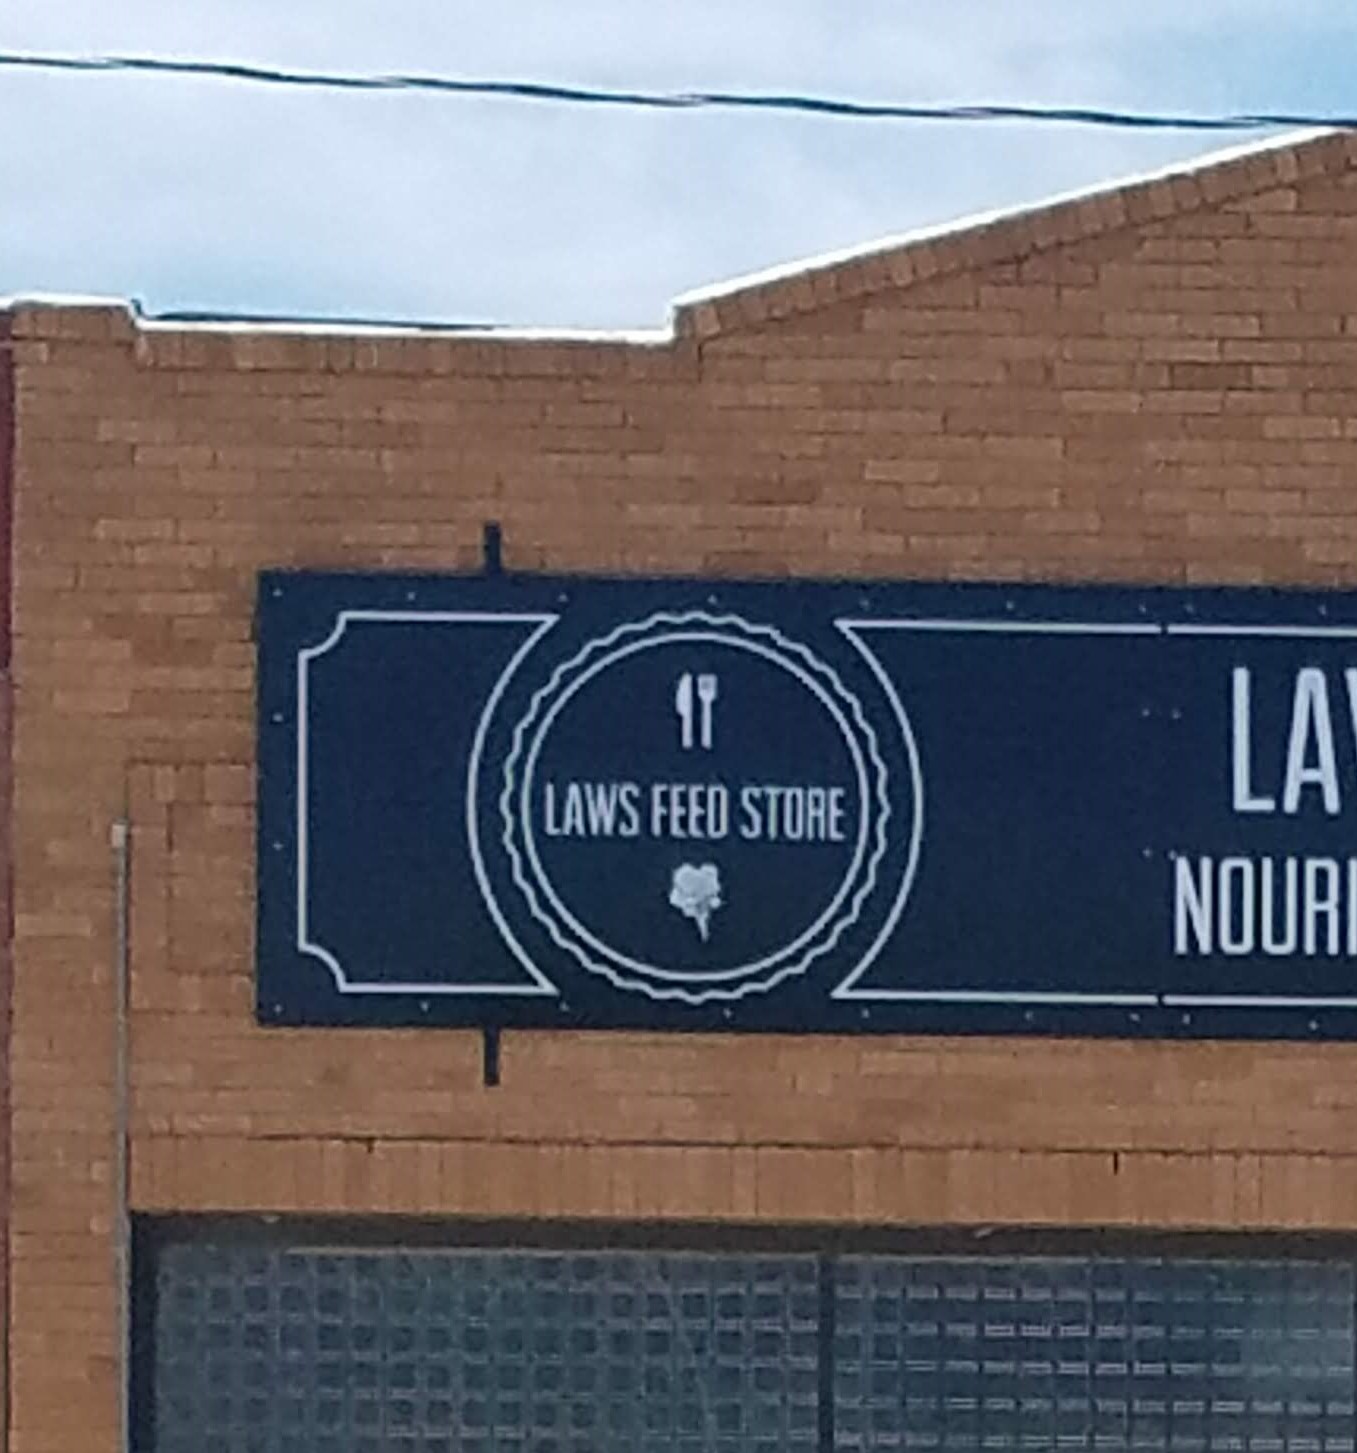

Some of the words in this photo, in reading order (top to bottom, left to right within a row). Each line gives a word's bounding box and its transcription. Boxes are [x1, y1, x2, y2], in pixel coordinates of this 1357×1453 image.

[545, 783, 640, 837] LAWS
[651, 784, 729, 839] FEED
[740, 787, 846, 841] STORE
